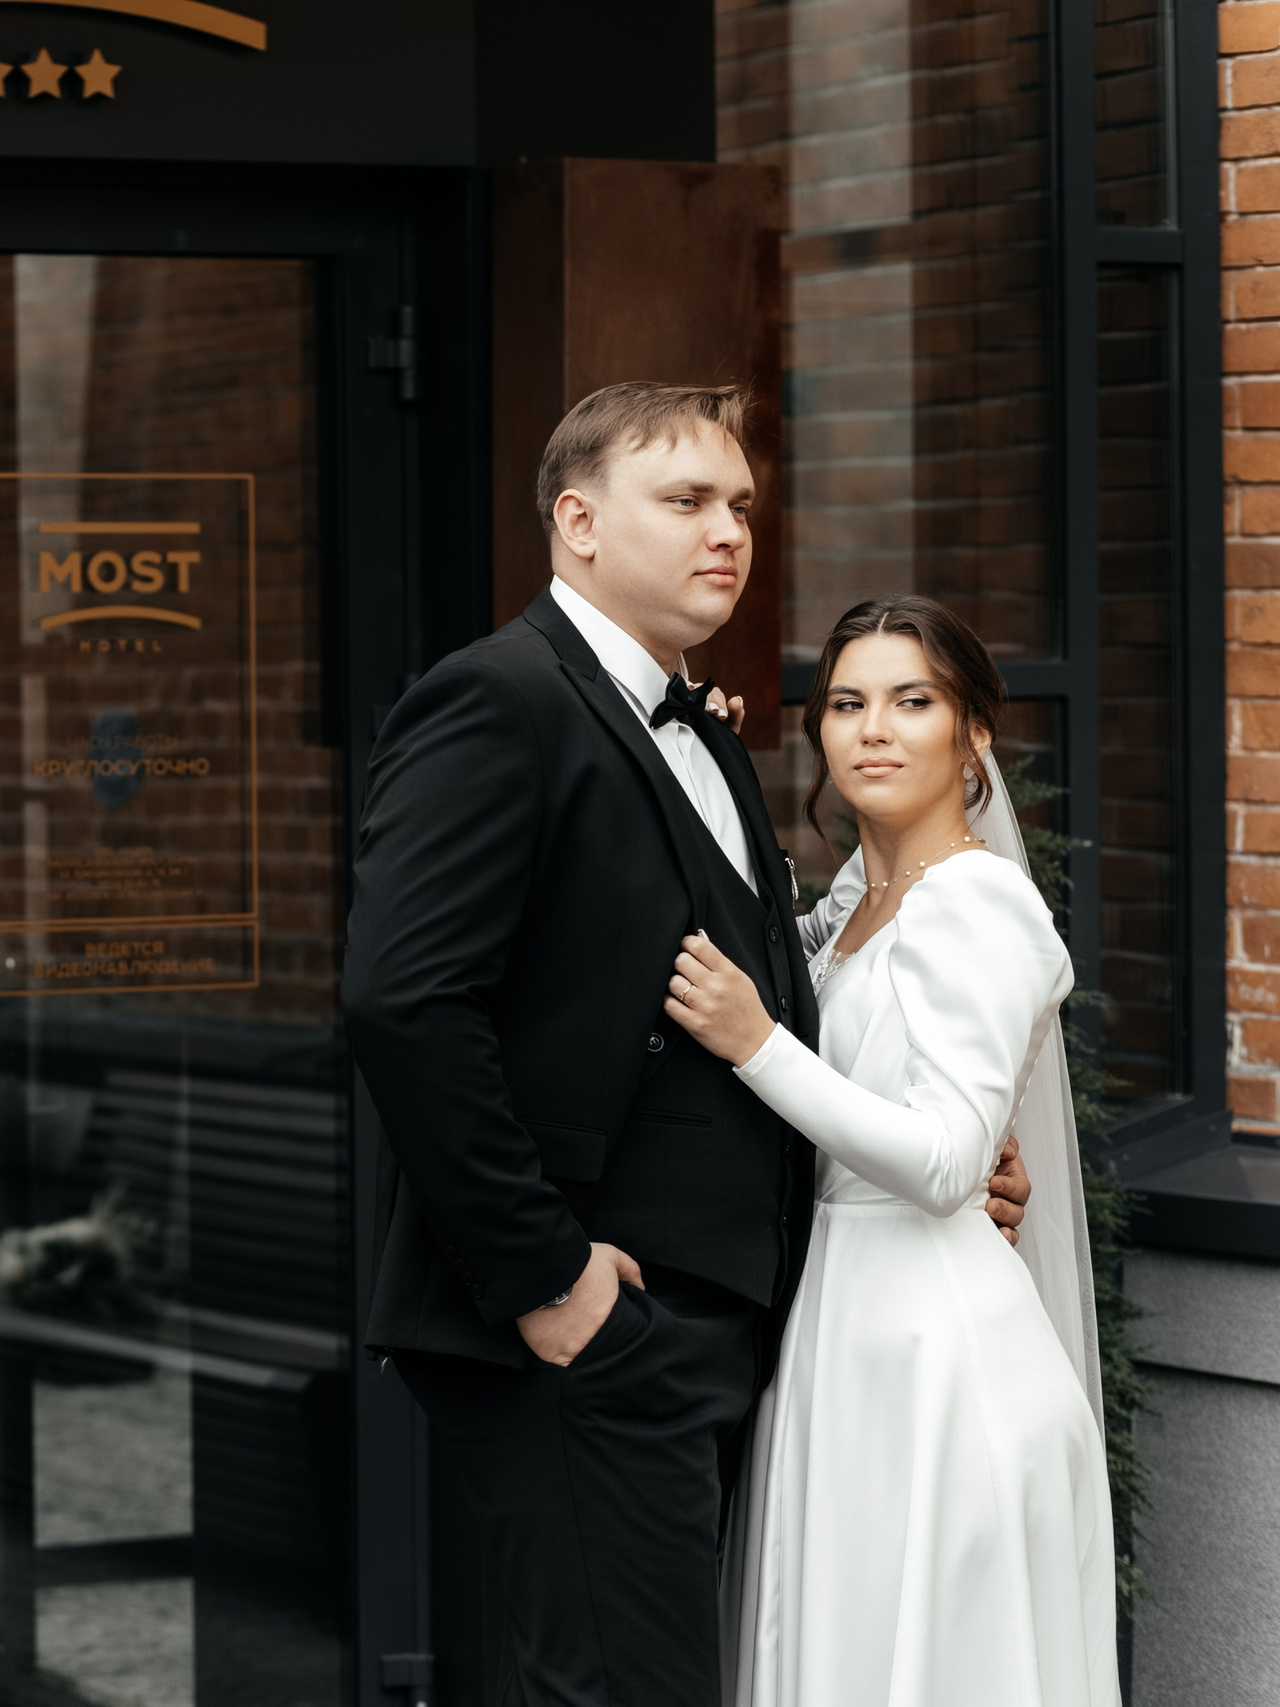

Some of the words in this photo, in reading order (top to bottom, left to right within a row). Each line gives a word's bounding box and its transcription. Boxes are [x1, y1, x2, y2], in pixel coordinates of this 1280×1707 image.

[39, 551, 201, 593] MOST
[79, 639, 162, 652] HOTEL
[34, 757, 210, 776] КРУГЛОСУТОЧНО
[85, 941, 164, 958] ВЕДЕТСЯ
[33, 958, 214, 978] ВИДЕОНАБЛЮДЕНИЕ
